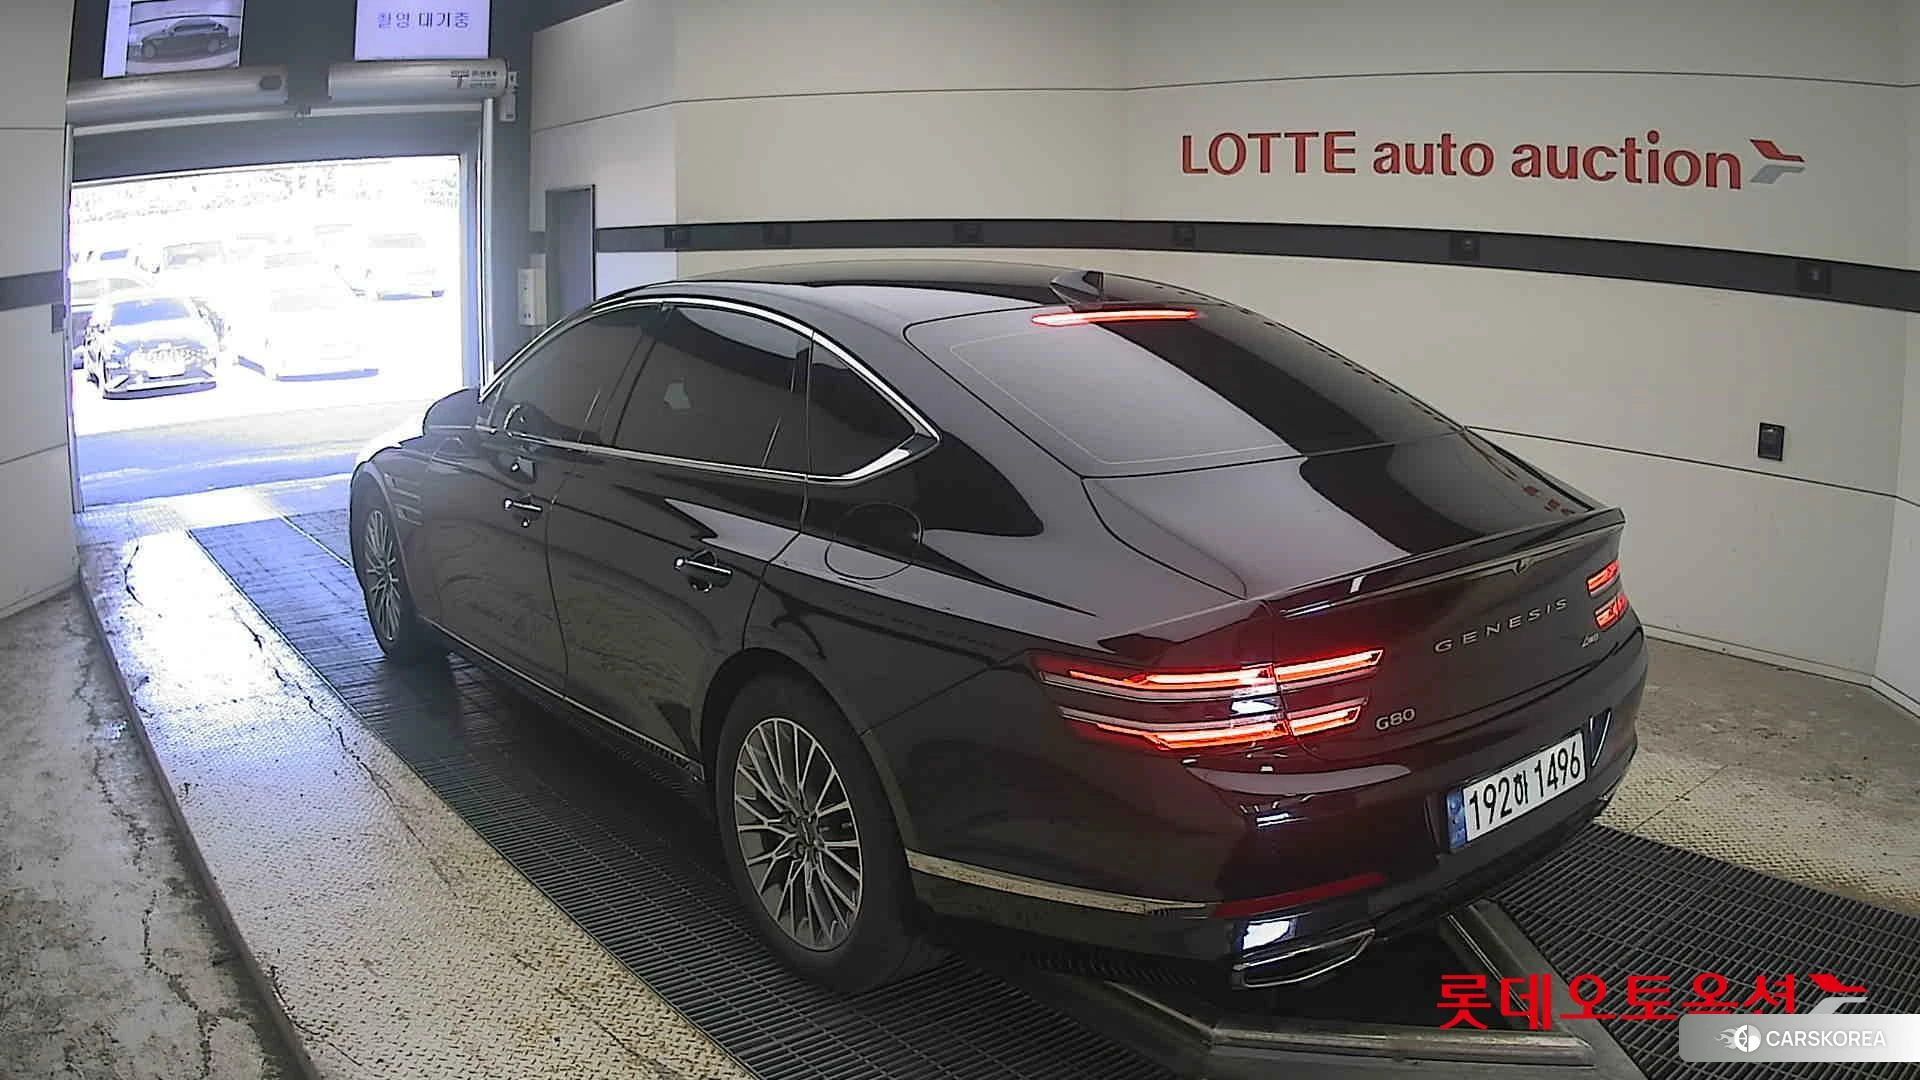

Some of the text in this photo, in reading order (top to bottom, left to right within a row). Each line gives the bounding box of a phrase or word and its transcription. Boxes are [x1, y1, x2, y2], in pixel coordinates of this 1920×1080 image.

[417, 11, 470, 29] 대기중
[1181, 130, 1741, 190] LOTTE auto auction
[1434, 598, 1569, 653] GENESIS
[1375, 707, 1417, 731] G80
[1468, 741, 1582, 831] 192하 1496
